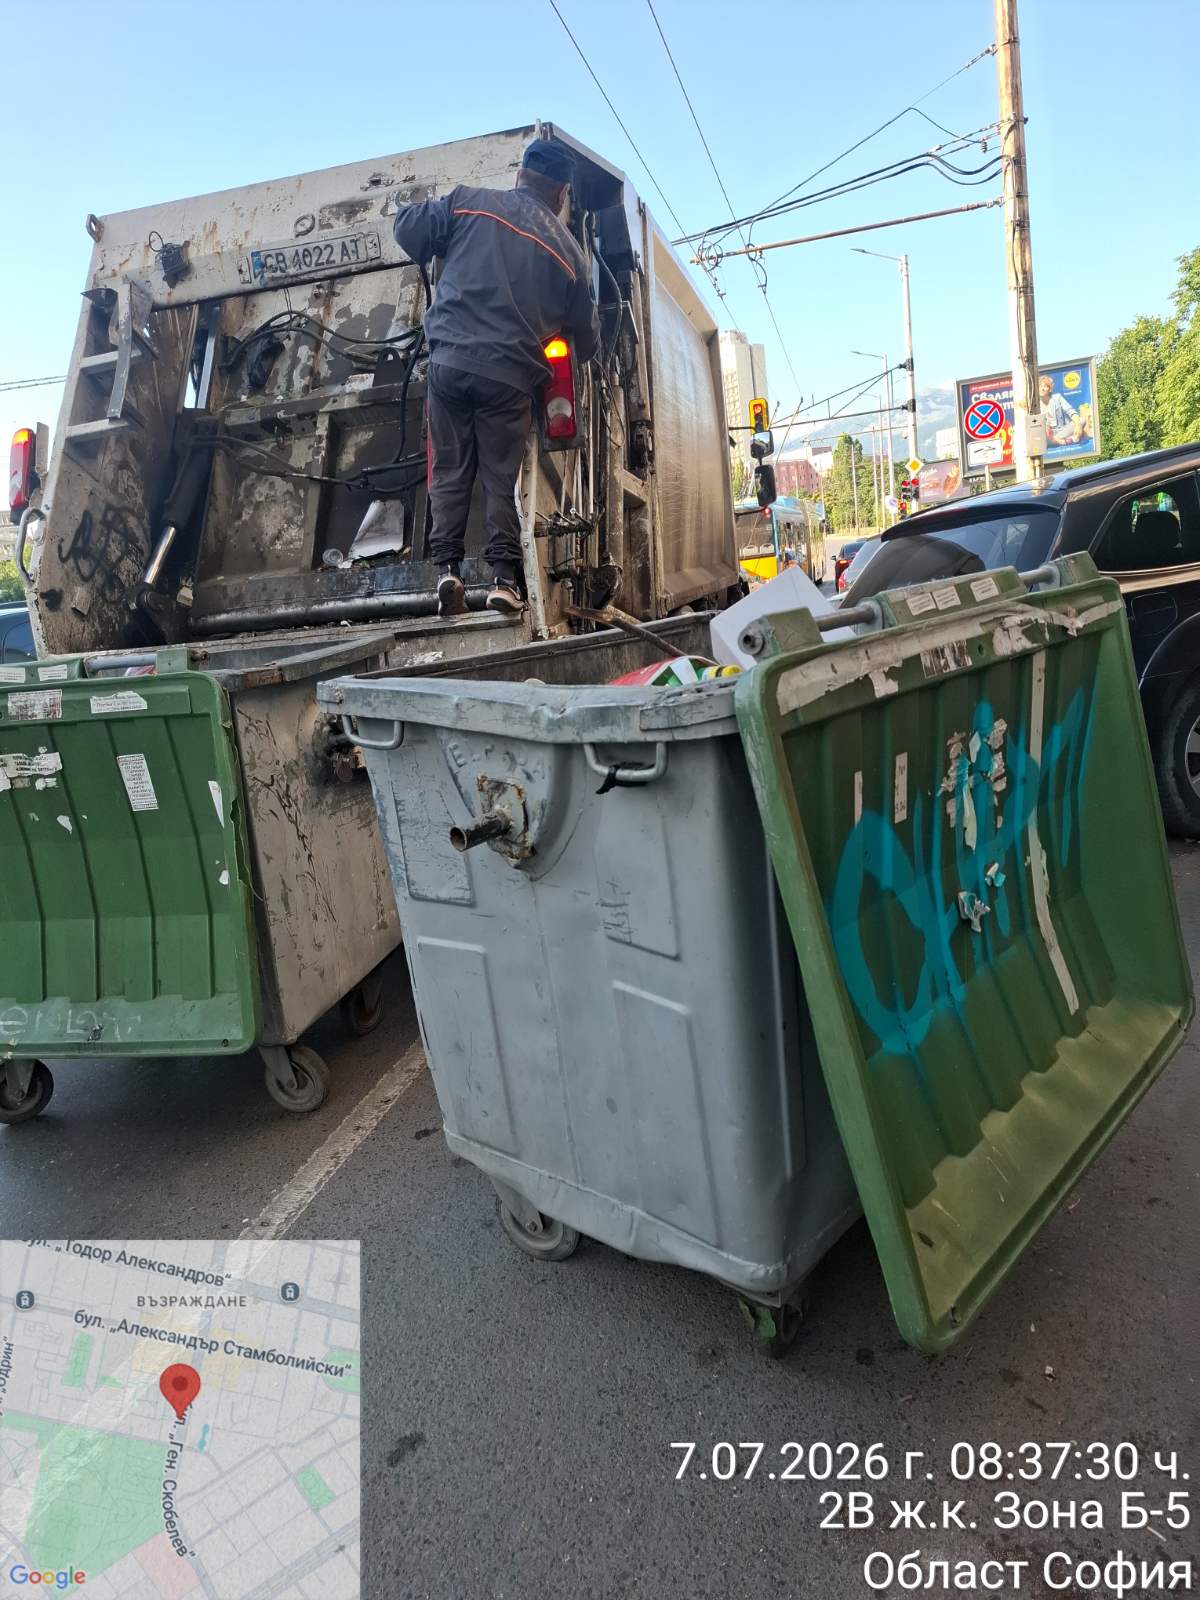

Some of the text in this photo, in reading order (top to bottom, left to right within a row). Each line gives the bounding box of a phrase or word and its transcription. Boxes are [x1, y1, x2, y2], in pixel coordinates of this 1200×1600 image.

[264, 239, 361, 274] CB 4022 AT
